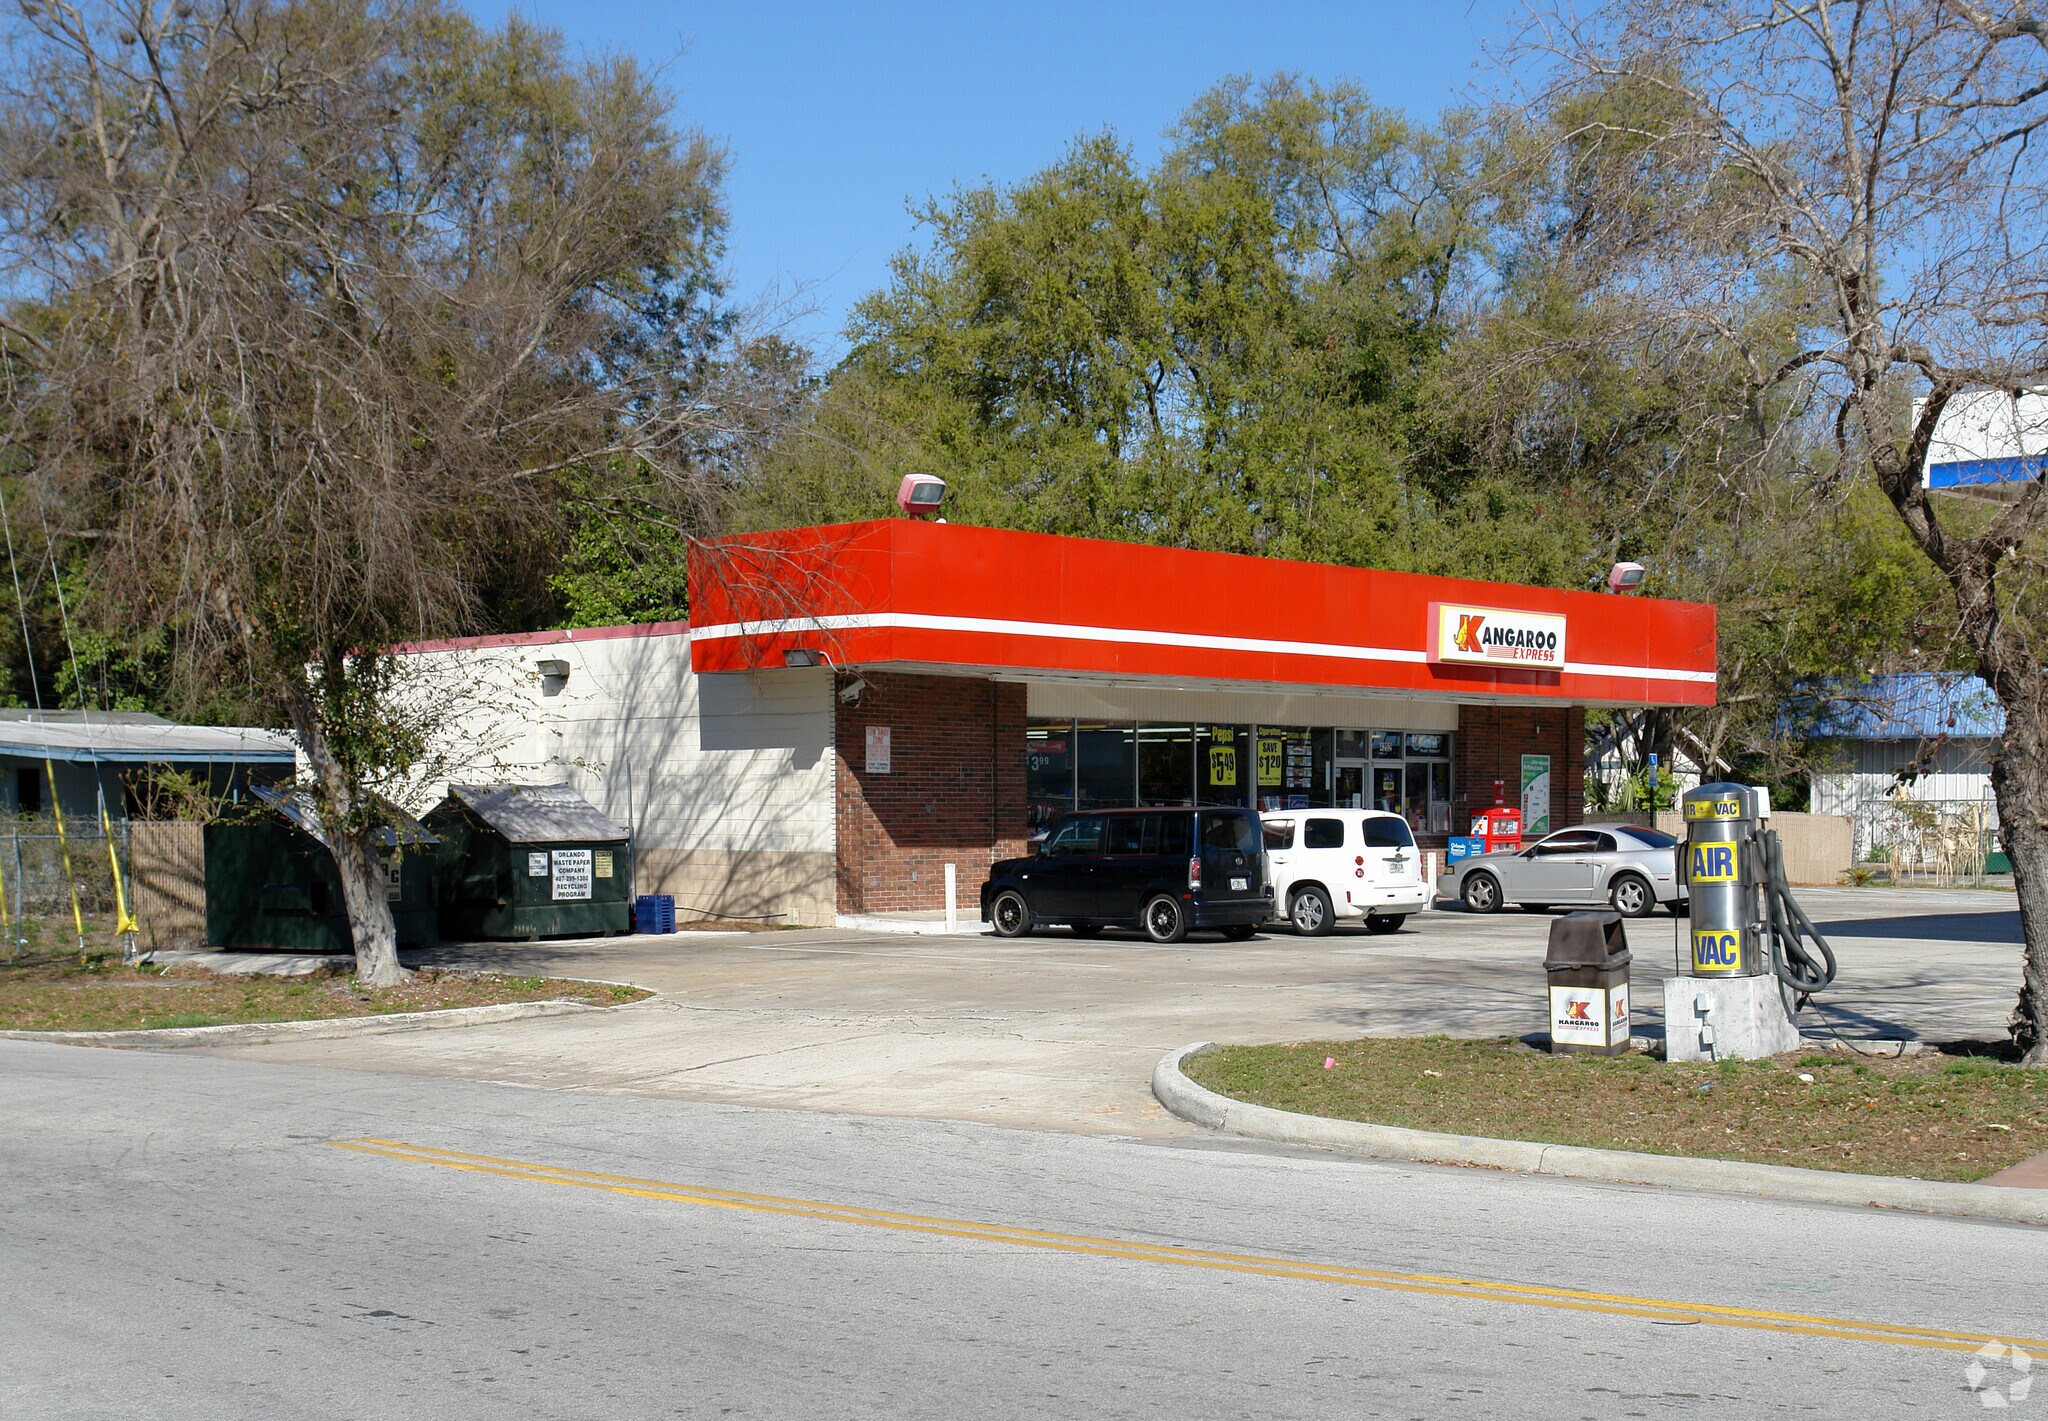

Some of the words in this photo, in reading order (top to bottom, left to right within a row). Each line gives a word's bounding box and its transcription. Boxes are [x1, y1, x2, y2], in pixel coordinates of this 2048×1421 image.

[1454, 614, 1557, 653] KANGAROO
[1513, 648, 1555, 662] EXPRESS
[1212, 727, 1234, 744] Pepsi
[1262, 742, 1278, 753] SAVE
[1685, 802, 1696, 816] IR
[1714, 802, 1737, 815] VAC
[1692, 847, 1733, 878] AIR
[1694, 935, 1737, 965] VAC
[1558, 1019, 1600, 1027] KANGAROO
